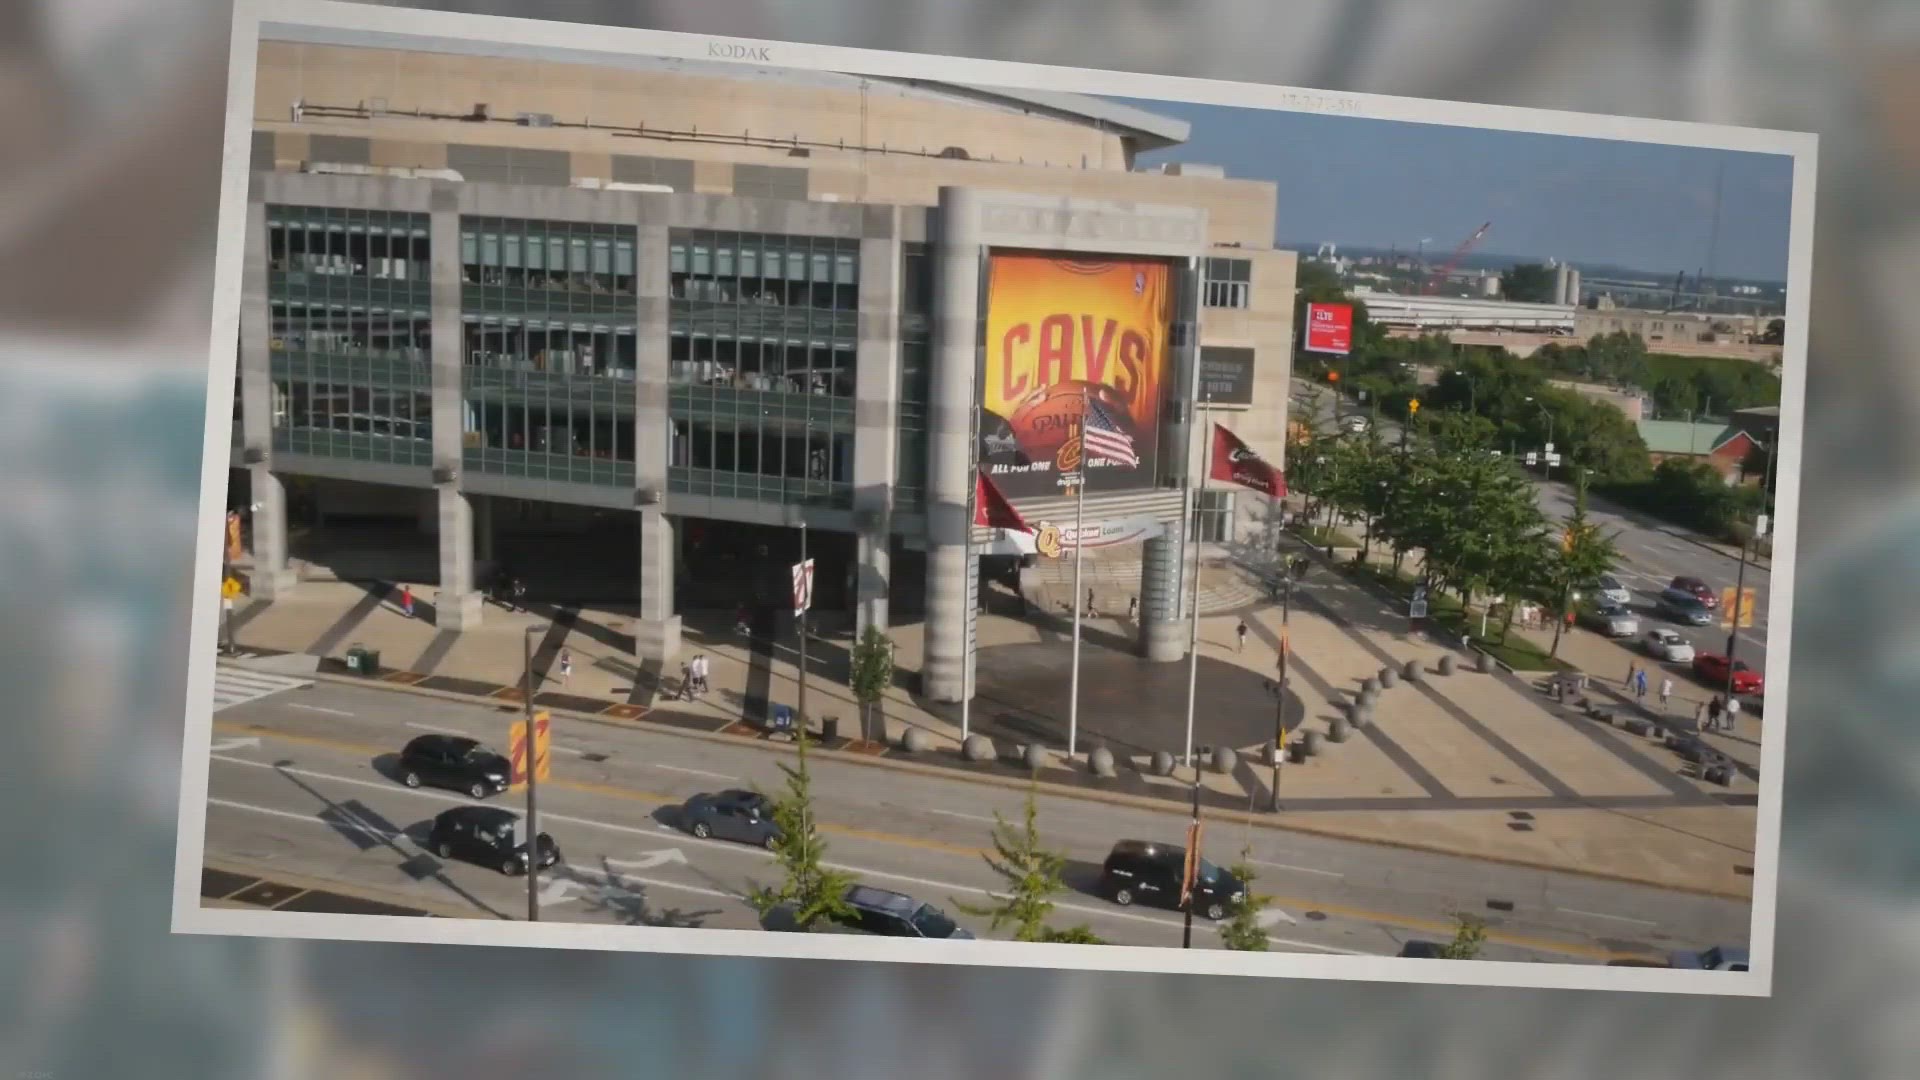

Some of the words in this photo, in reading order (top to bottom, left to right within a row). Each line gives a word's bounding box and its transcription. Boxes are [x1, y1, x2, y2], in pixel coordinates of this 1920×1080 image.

[1002, 313, 1148, 405] CAVS
[991, 464, 1008, 474] ALL
[1031, 461, 1051, 472] ONE
[1087, 457, 1105, 468] ONE
